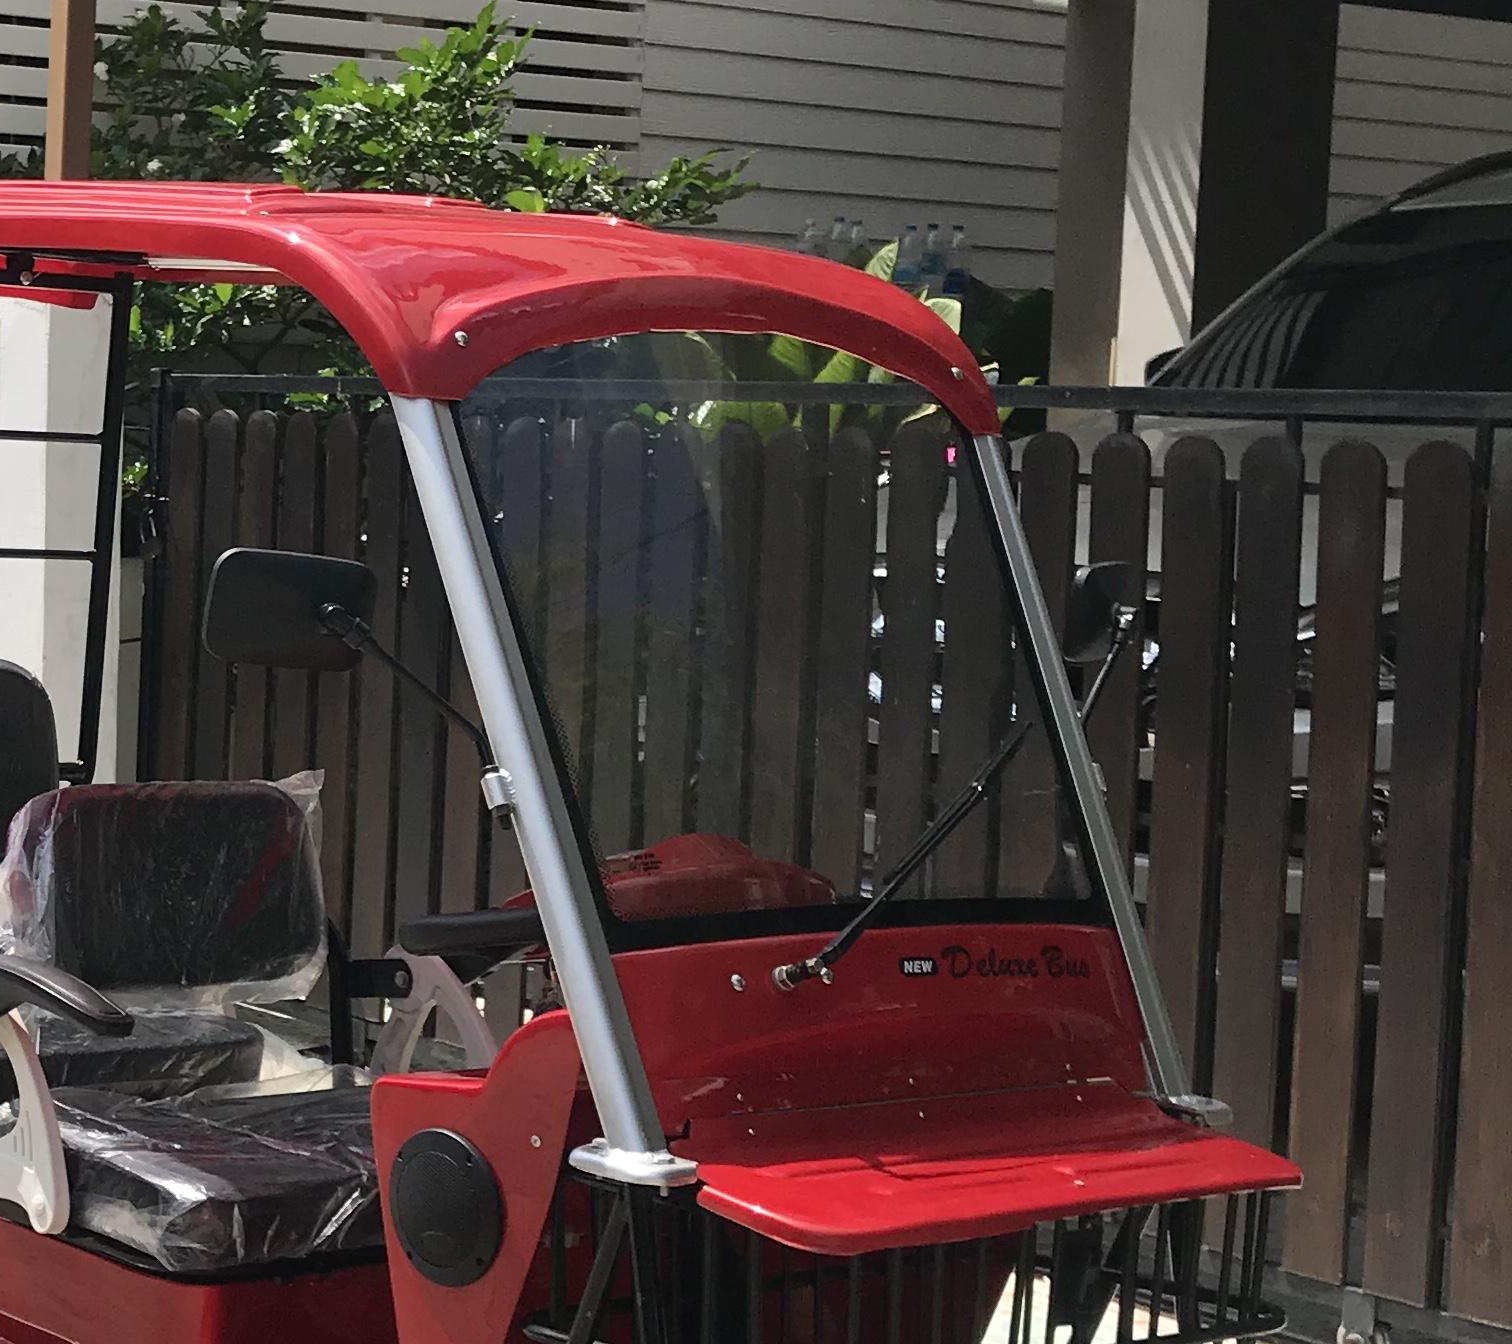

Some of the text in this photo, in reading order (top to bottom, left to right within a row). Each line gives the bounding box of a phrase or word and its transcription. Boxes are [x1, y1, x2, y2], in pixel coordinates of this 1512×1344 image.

[900, 944, 1089, 978] NEW Deluxe Bus
